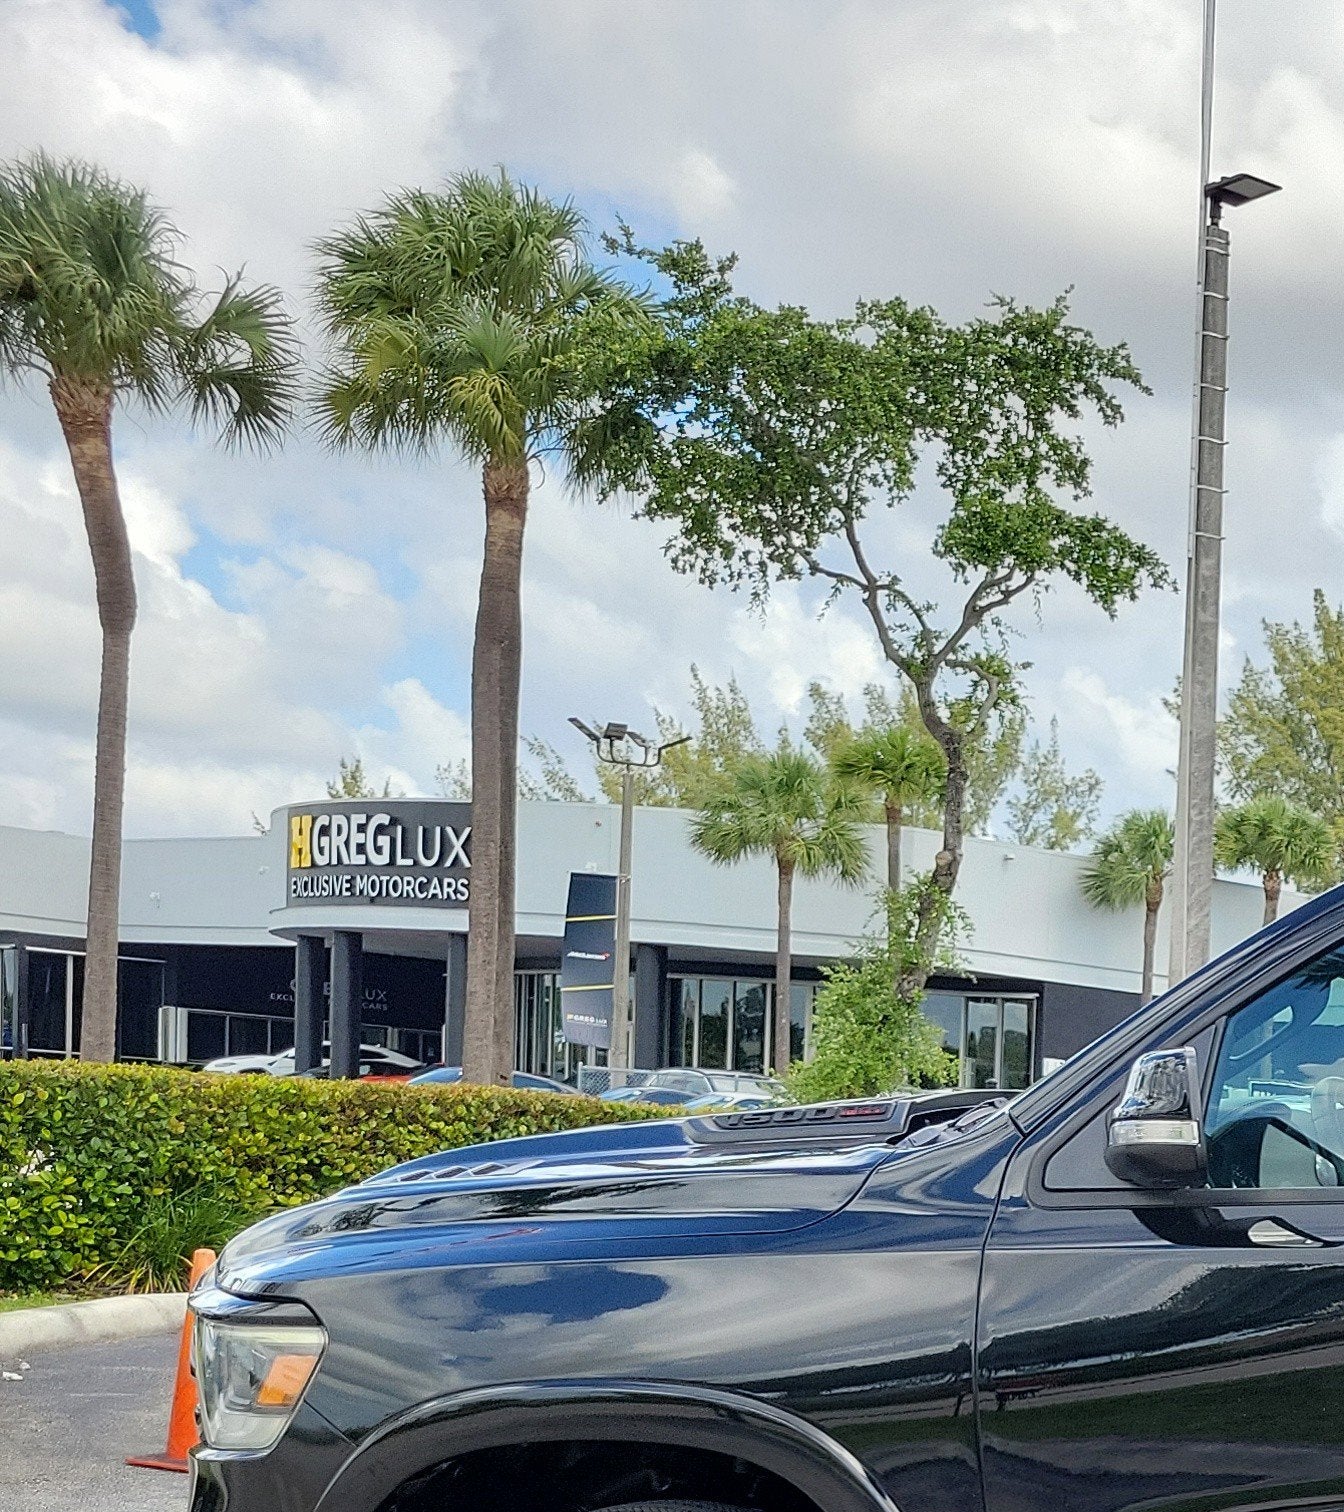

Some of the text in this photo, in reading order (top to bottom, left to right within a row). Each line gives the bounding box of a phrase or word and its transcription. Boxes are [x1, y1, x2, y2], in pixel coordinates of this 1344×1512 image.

[291, 875, 470, 900] EXCLUSIVE MOTORCARS
[726, 1108, 838, 1127] 1500
